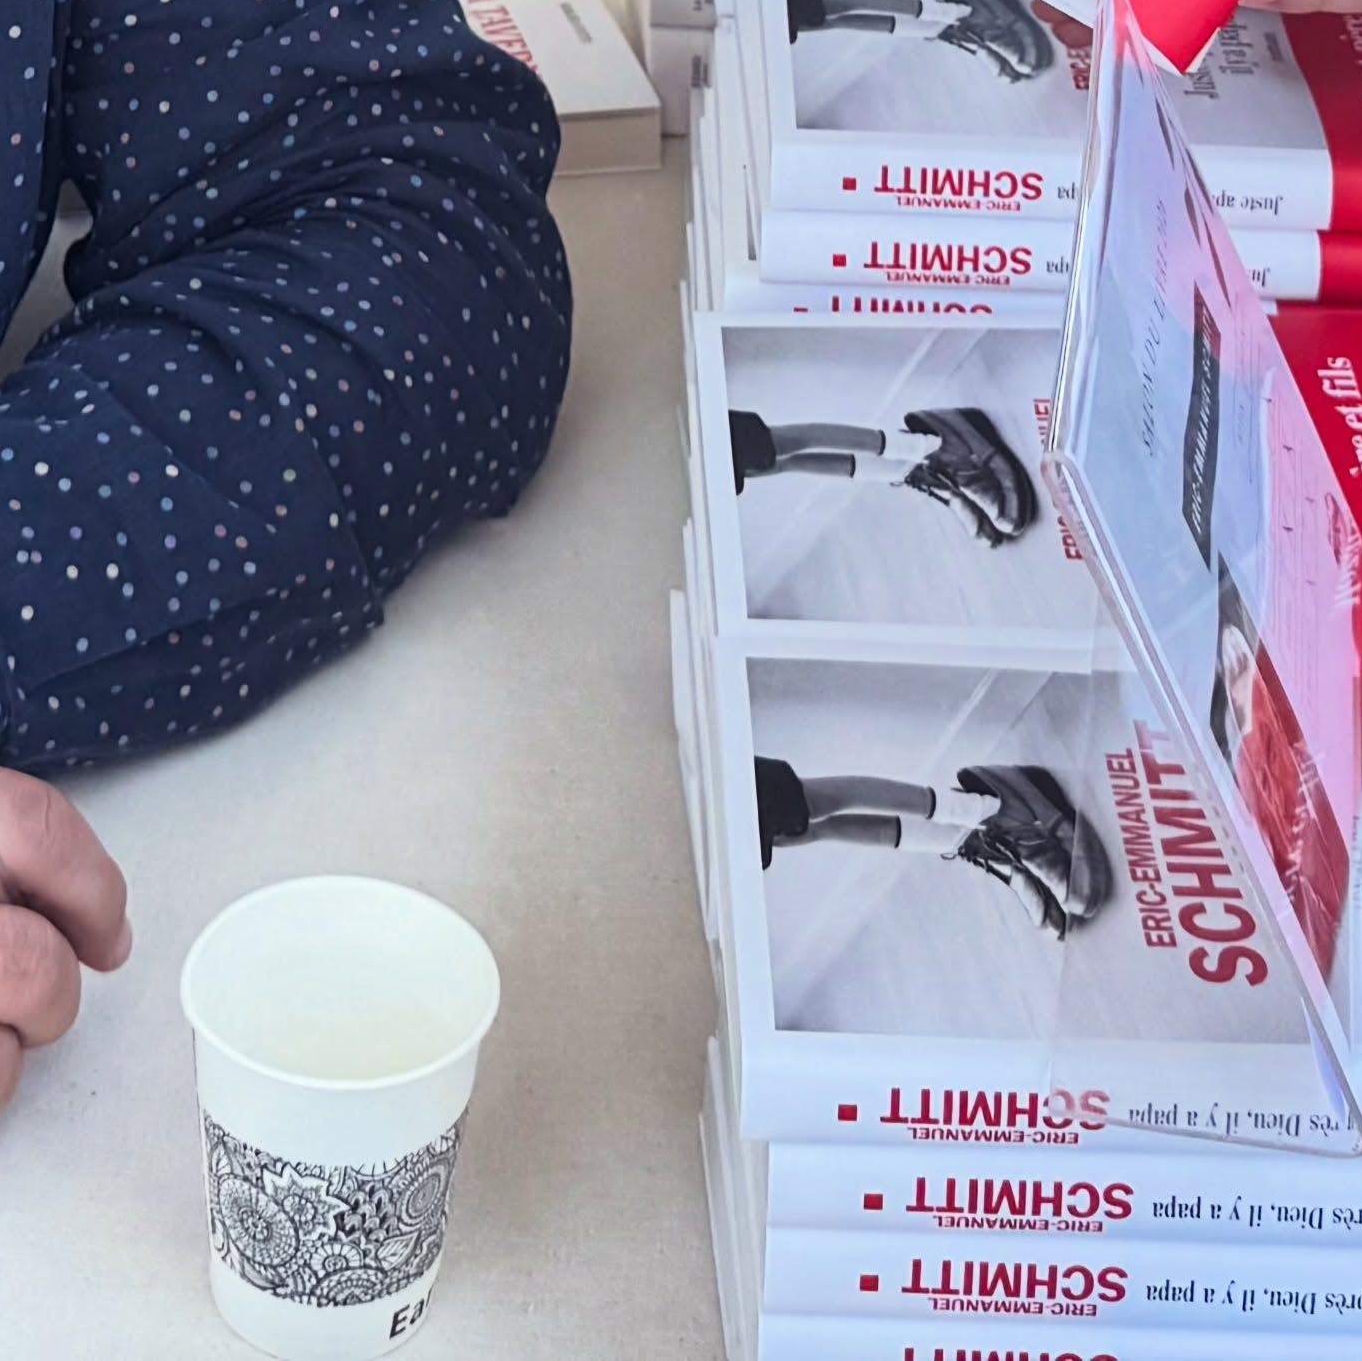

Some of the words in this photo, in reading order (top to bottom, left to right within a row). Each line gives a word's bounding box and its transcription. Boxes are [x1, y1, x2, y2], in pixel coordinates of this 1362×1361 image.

[874, 165, 1044, 201] SCHMITT
[1241, 196, 1283, 215] Juste
[863, 241, 1033, 275] SCHMITT
[1317, 357, 1362, 400] fils
[1105, 747, 1177, 948] ERIC-EMMANUEL
[1133, 719, 1268, 987] SCHMITT
[880, 1087, 1111, 1130] SCHMITT
[907, 1126, 1079, 1145] ERIC-EMMANUEL
[905, 1177, 1134, 1220] SCHMITT
[1152, 1196, 1202, 1220] papa
[1229, 1195, 1242, 1221] y
[932, 1214, 1103, 1233] ERIC-EMMANUEL
[1210, 1203, 1221, 1220] a
[1249, 1204, 1262, 1227] il
[1270, 1203, 1324, 1230] Dieu,
[901, 1258, 1129, 1303] SCHMITT
[1145, 1279, 1195, 1304] papa
[1222, 1280, 1235, 1305] y
[928, 1297, 1098, 1317] ERIC-EMMANUEL
[1203, 1287, 1215, 1304] a
[1242, 1287, 1255, 1312] il
[1263, 1287, 1317, 1315] Dieu,
